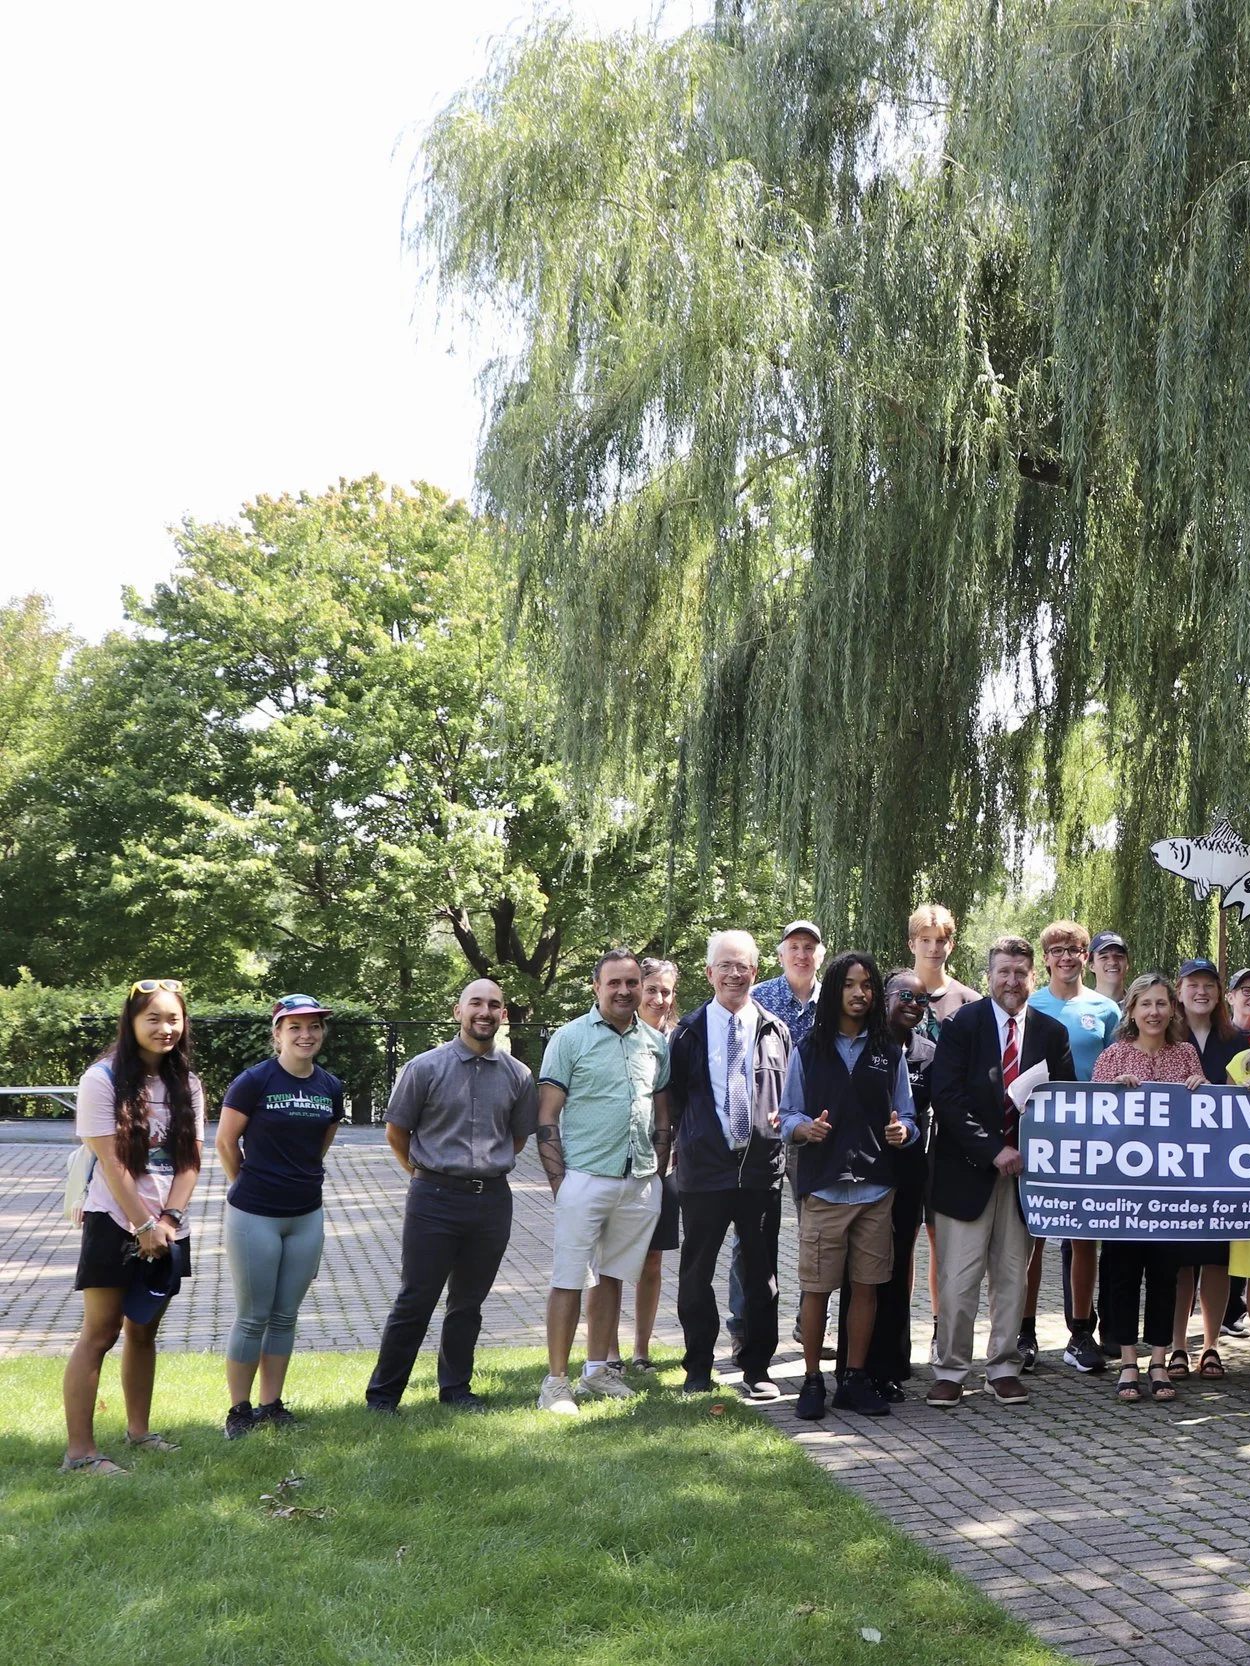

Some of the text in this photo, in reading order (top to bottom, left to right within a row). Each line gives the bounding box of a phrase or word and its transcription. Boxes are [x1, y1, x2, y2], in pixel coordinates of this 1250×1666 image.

[266, 1093, 292, 1102] TWIN
[266, 1101, 333, 1114] HALF MARATHON
[1029, 1091, 1170, 1127] THREE
[1027, 1138, 1211, 1178] REPORT
[1026, 1194, 1077, 1210] Water
[1081, 1198, 1143, 1215] Quality
[1148, 1199, 1208, 1213] Grades
[1212, 1200, 1238, 1213] for
[1027, 1212, 1083, 1229] Mystic,
[1088, 1216, 1121, 1229] and
[1125, 1216, 1205, 1233] Neponset
